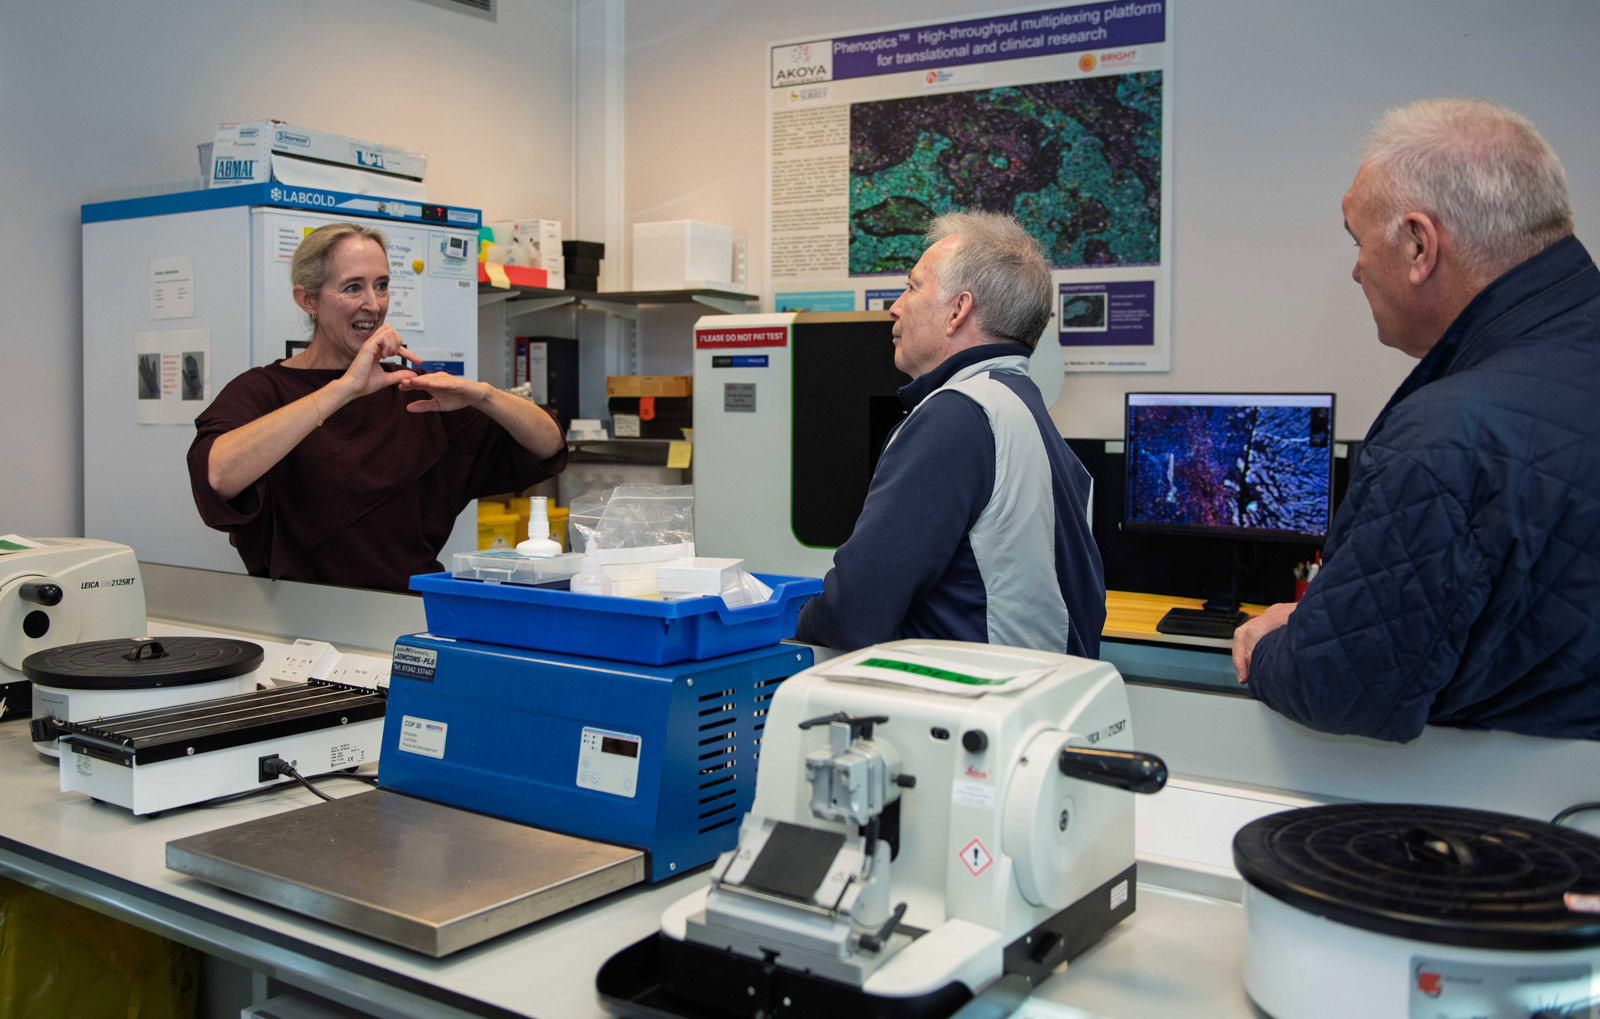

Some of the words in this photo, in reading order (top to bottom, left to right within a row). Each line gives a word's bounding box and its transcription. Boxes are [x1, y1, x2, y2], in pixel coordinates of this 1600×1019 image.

[917, 22, 1018, 45] High-throughput
[1021, 11, 1100, 32] multiplexing
[1104, 2, 1162, 21] platform
[876, 53, 892, 67] for
[895, 43, 969, 66] translational
[972, 40, 997, 56] and
[1000, 34, 1044, 51] clinical
[1047, 27, 1107, 46] research
[1100, 51, 1137, 63] BRIGHT
[776, 65, 828, 80] AKOYA
[214, 159, 255, 180] LABMAT
[283, 189, 335, 207] LABCOLD
[700, 334, 724, 342] PLEASE
[726, 333, 736, 341] DO
[737, 333, 752, 341] NOT
[766, 332, 784, 340] TEST
[81, 580, 99, 589] LEICA
[111, 578, 135, 587] 2125RT
[401, 665, 416, 674] 01342
